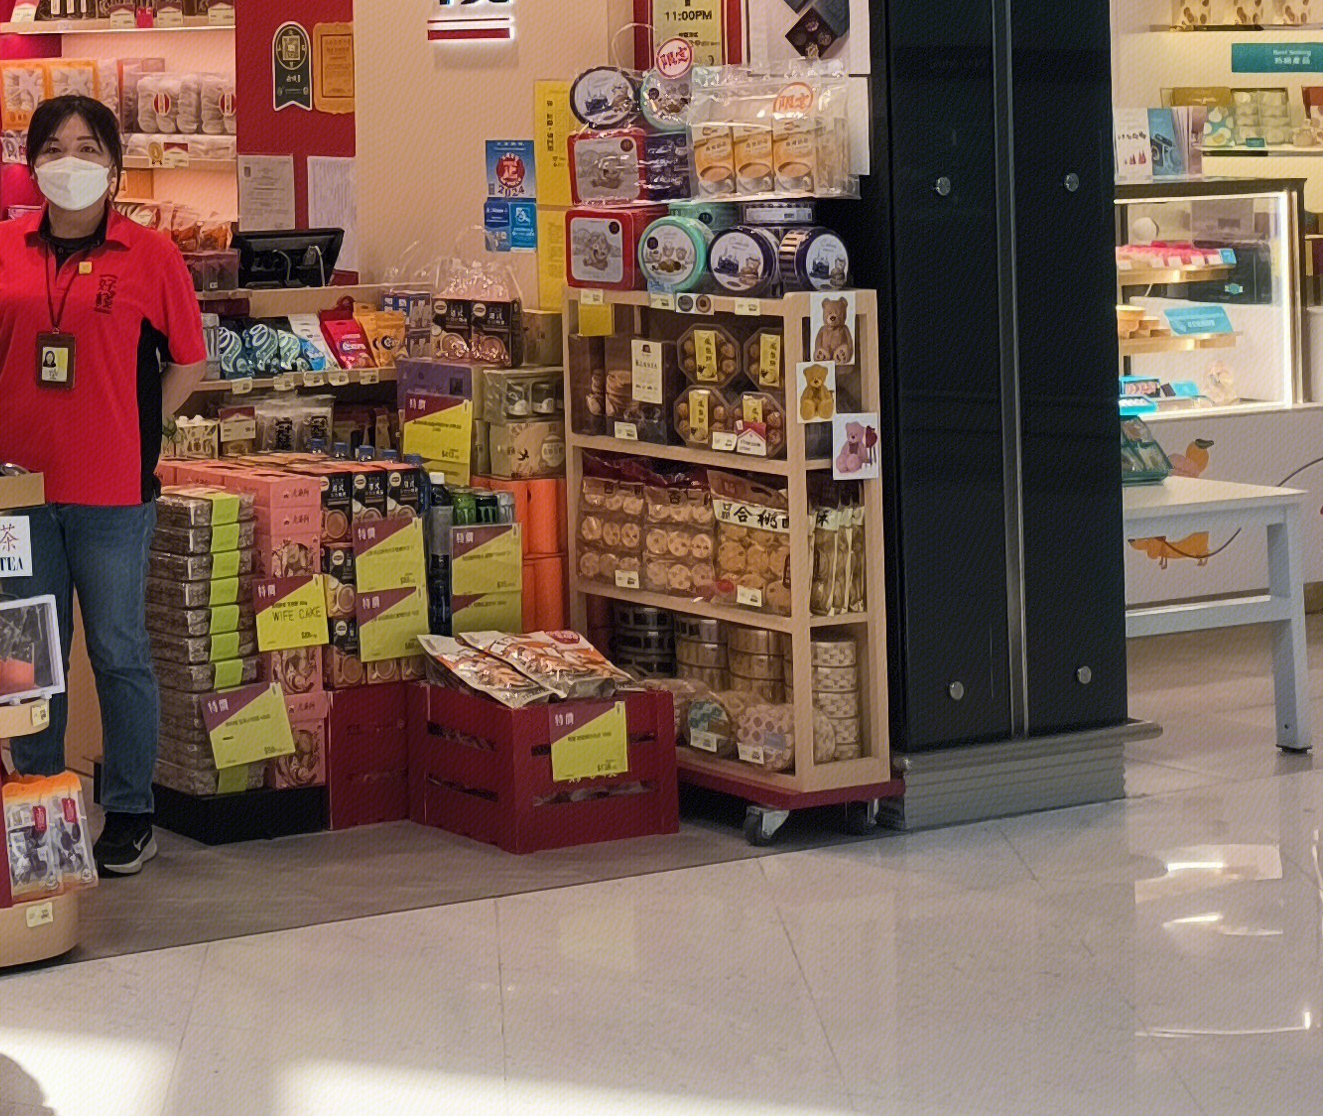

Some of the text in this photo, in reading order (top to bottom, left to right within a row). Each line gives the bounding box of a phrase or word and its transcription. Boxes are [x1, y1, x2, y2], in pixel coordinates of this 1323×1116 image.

[664, 10, 713, 21] 11:00PM
[497, 185, 525, 197] 2024
[271, 605, 322, 623] WIFE CAKE
